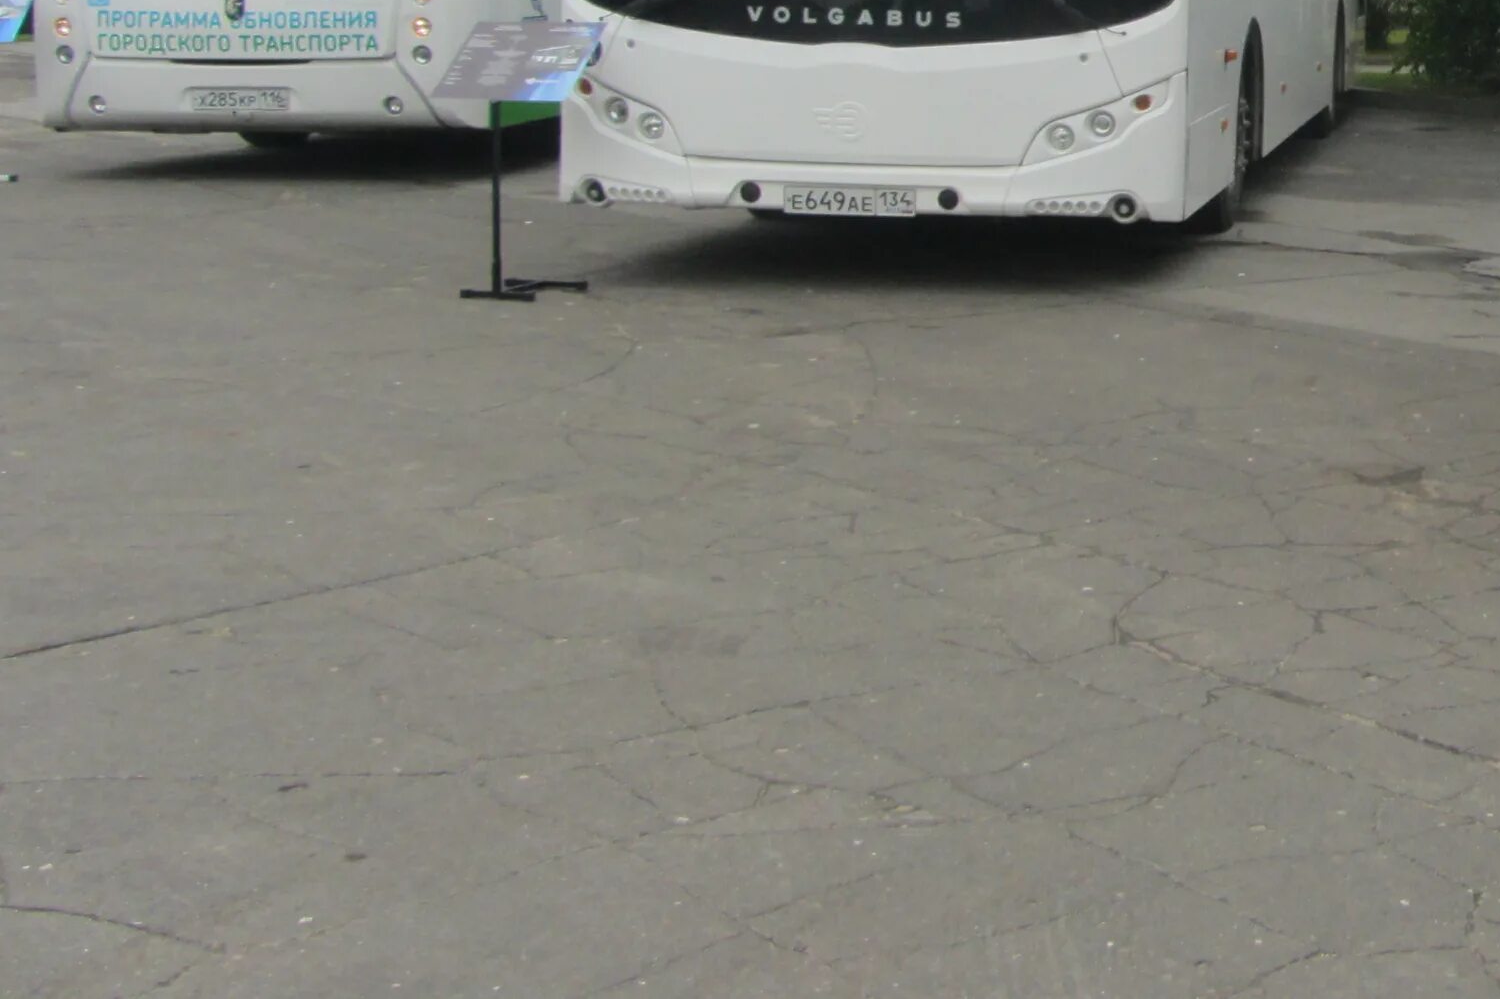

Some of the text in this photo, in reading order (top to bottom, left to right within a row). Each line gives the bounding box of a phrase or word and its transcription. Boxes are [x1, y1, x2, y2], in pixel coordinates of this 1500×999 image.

[96, 10, 221, 28] ПРОГРАММА
[747, 5, 962, 29] VOLGABUS
[97, 33, 380, 55] ГОРОДСКОГО ТРАНСПОРТА
